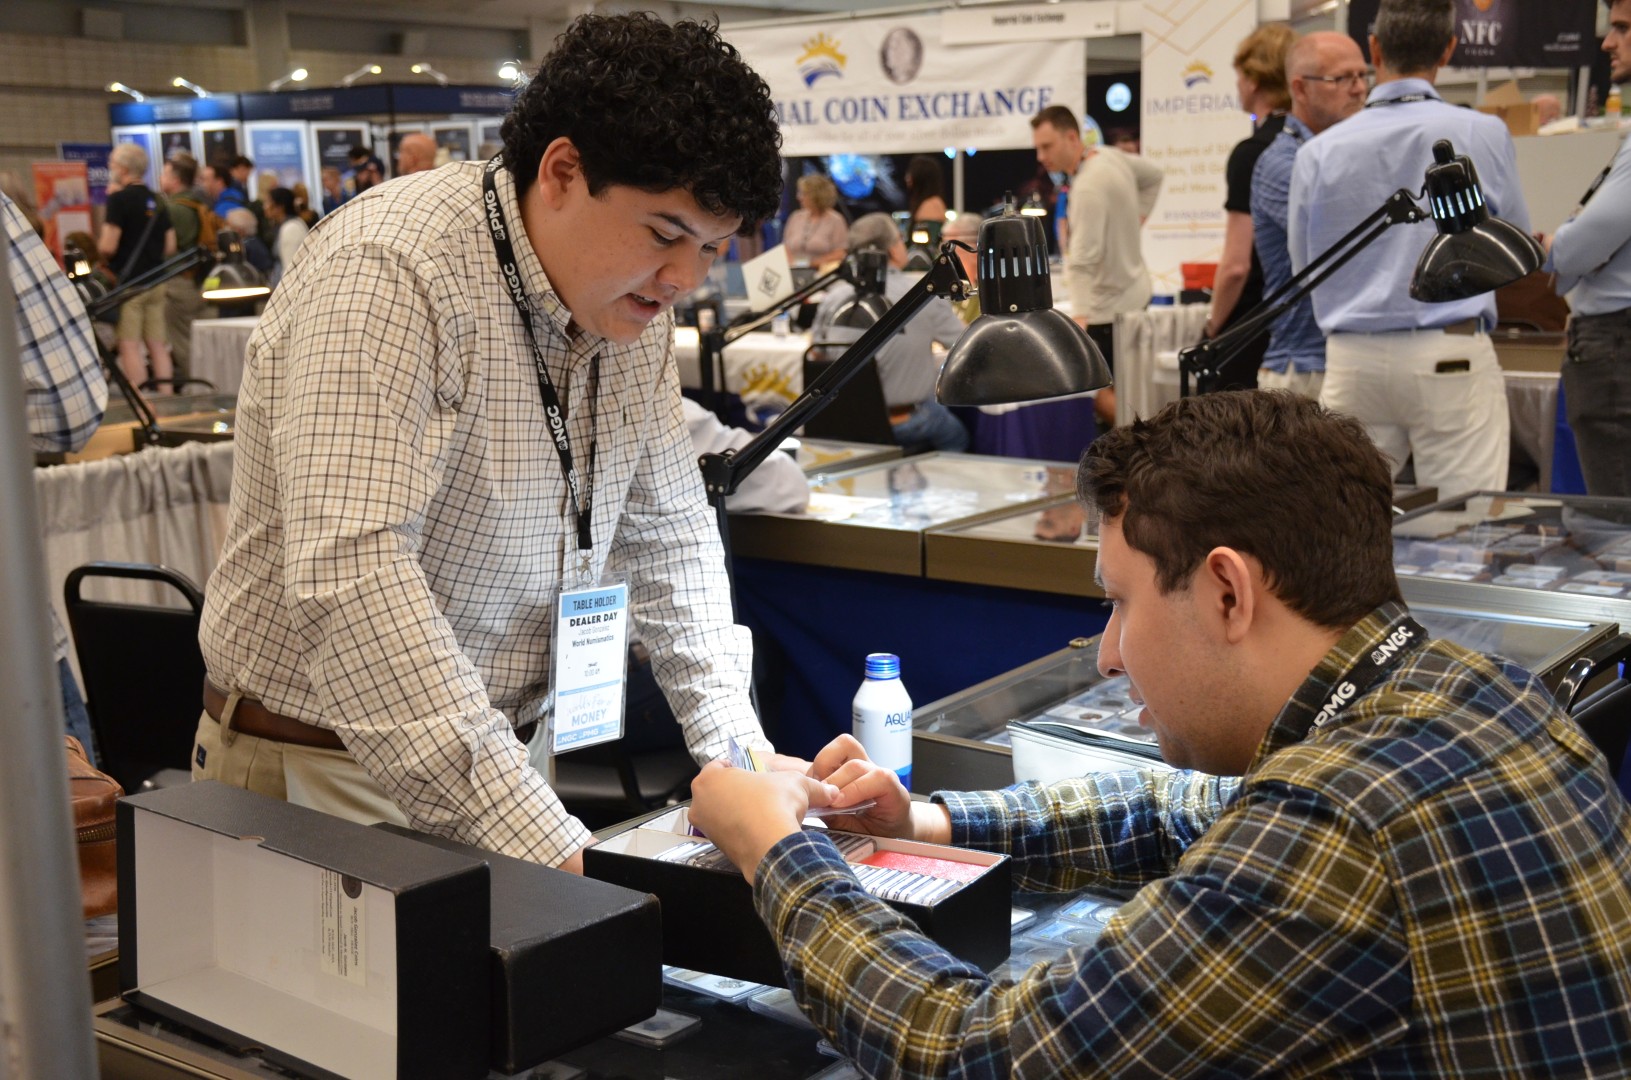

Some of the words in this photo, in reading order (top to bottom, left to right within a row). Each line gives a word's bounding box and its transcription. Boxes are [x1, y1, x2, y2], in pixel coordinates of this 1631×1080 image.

[1459, 19, 1502, 46] NFC
[776, 100, 820, 125] IAL
[824, 96, 889, 124] COIN
[901, 87, 1054, 121] EXCHANGE
[485, 189, 505, 231] PMG
[503, 262, 526, 303] NGC
[547, 404, 569, 442] NGC
[573, 599, 593, 612] TABLE
[594, 595, 617, 609] HOLDER
[569, 615, 602, 627] DEALER
[603, 611, 618, 623] DAY
[572, 638, 586, 648] World
[586, 634, 615, 646] Numismatics
[1378, 626, 1414, 658] NGC
[571, 708, 607, 727] MONEY
[1314, 681, 1357, 727] PMG
[885, 711, 912, 727] AQUA
[561, 733, 578, 743] NGC
